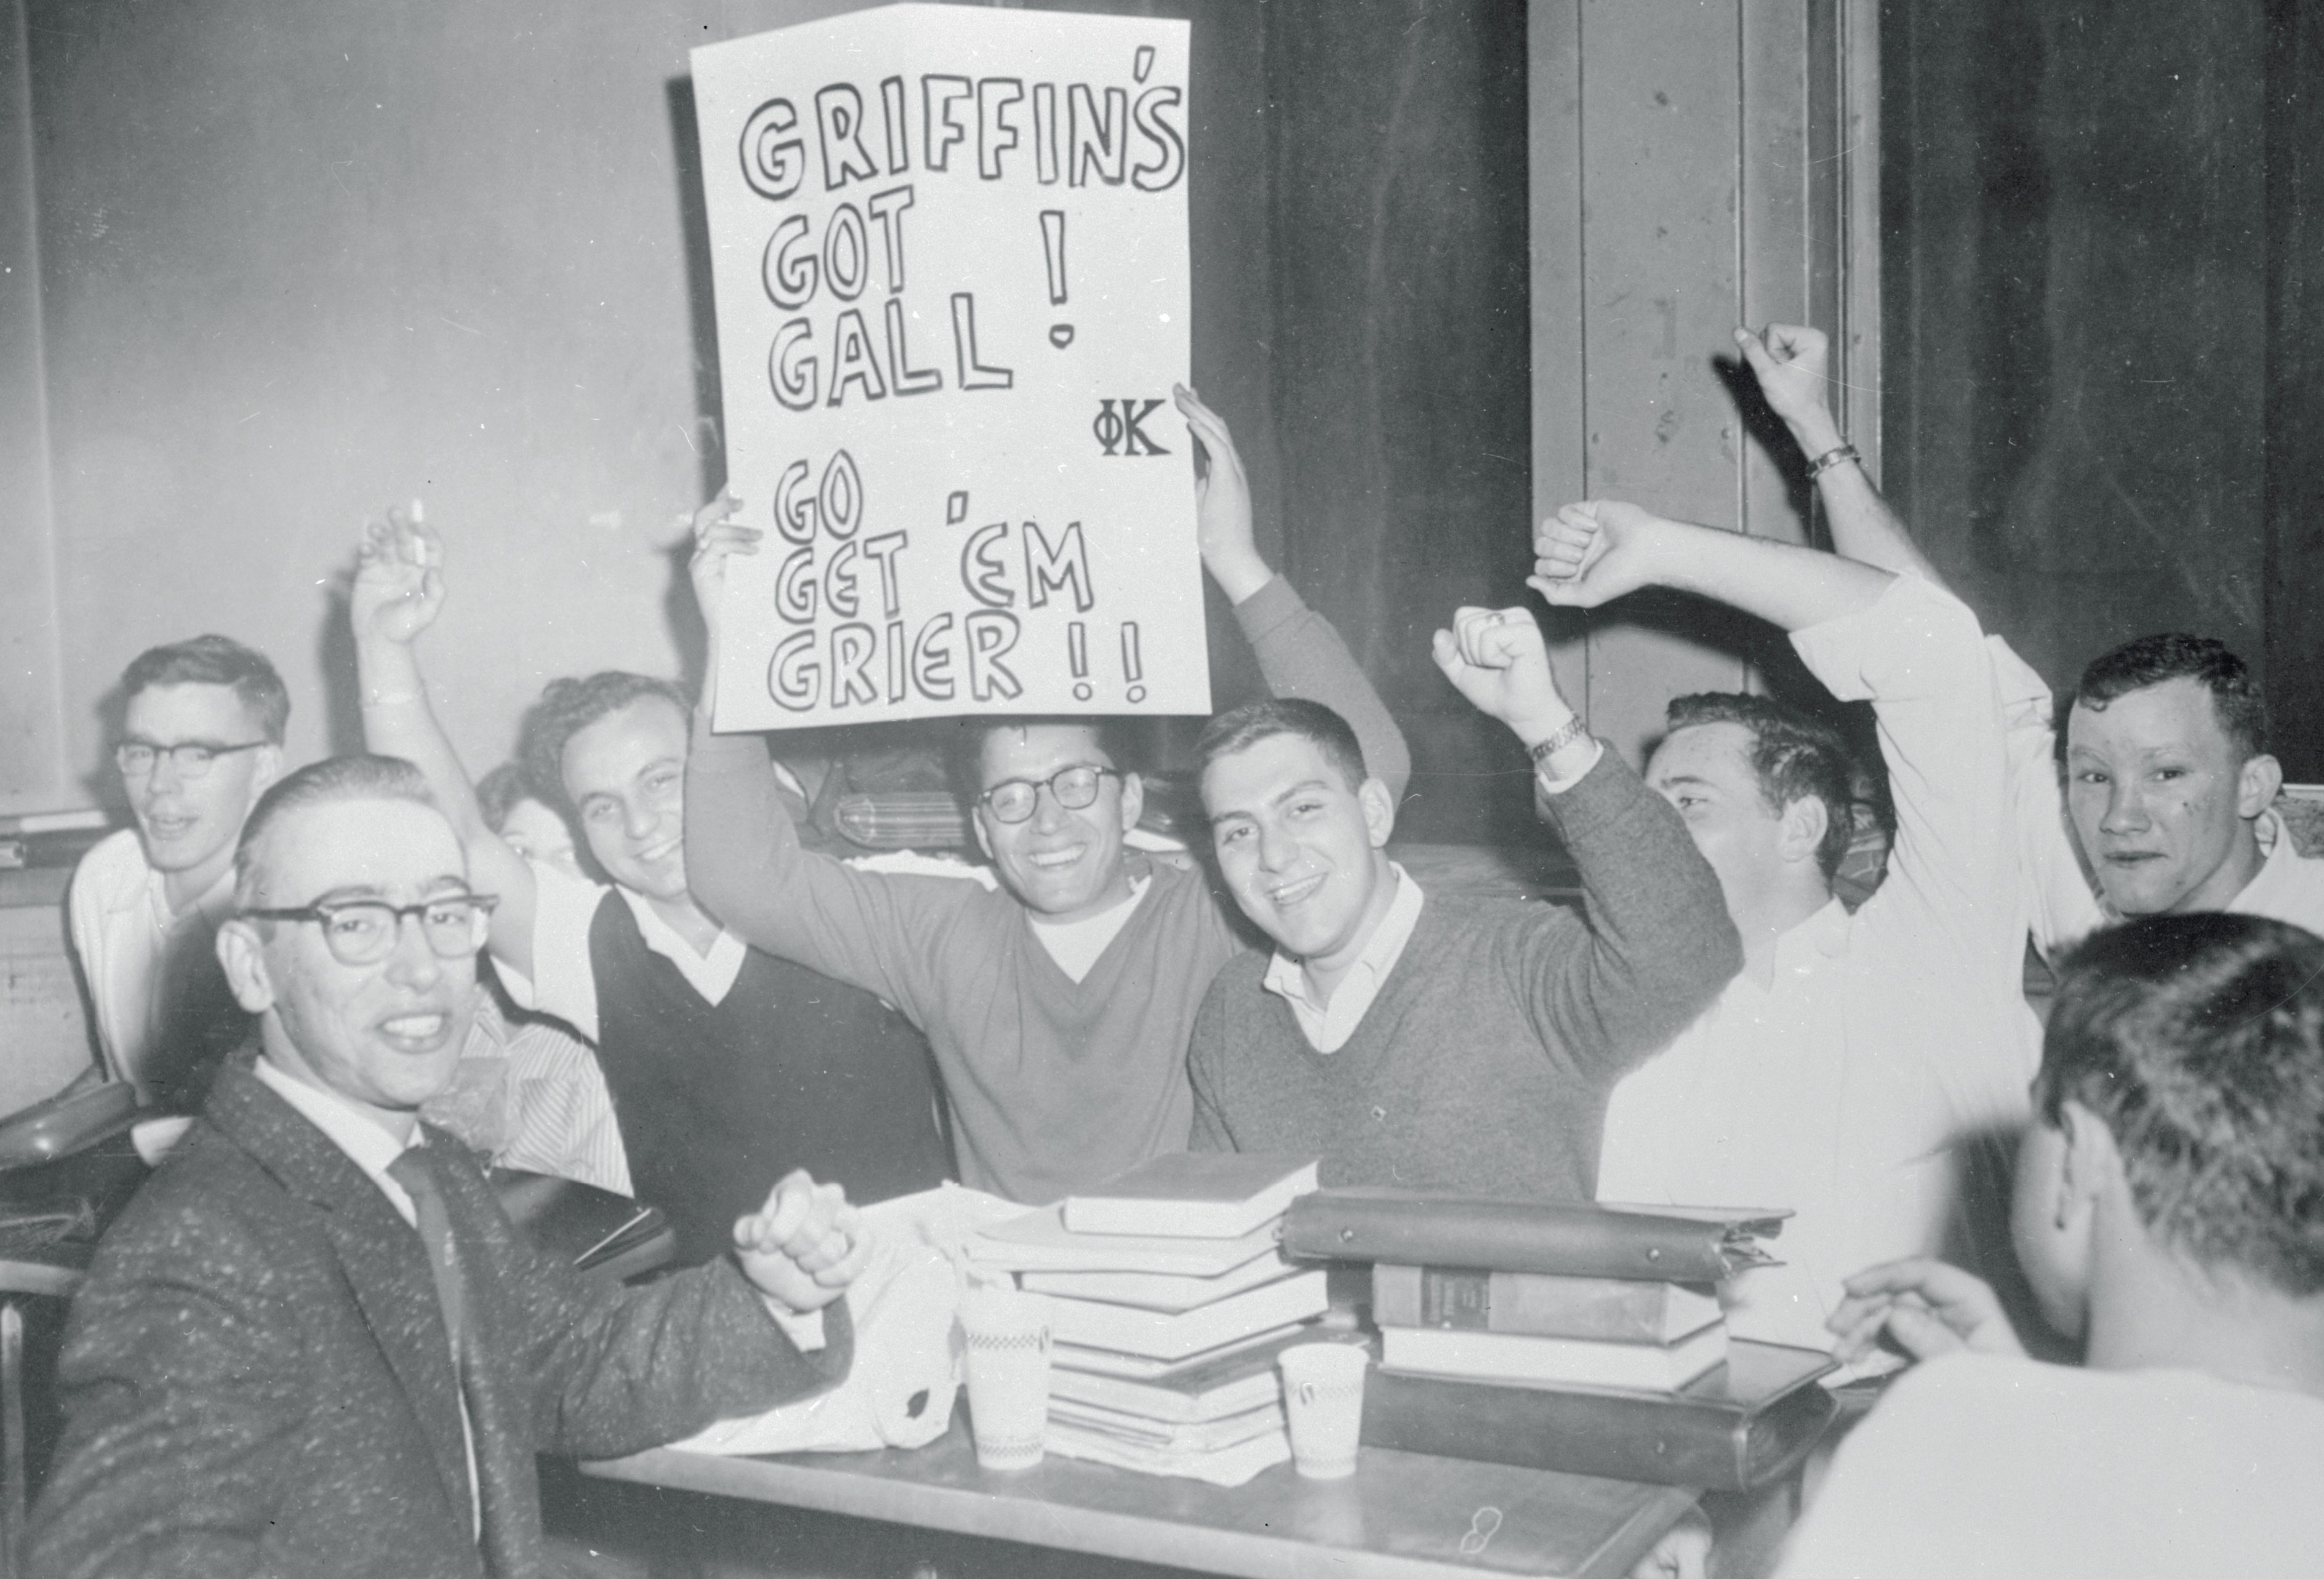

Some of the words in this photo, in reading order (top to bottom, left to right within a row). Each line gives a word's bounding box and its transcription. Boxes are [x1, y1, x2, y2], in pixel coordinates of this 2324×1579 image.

[740, 45, 1185, 201] GRIFFIN'S
[762, 185, 915, 311] GOT
[1040, 210, 1075, 349] !
[769, 292, 1013, 411] GALL
[1093, 399, 1172, 456] ΦK
[774, 448, 863, 545] GO
[775, 529, 908, 624] GET
[946, 491, 1094, 613] 'EM
[767, 608, 1024, 712] GRIER
